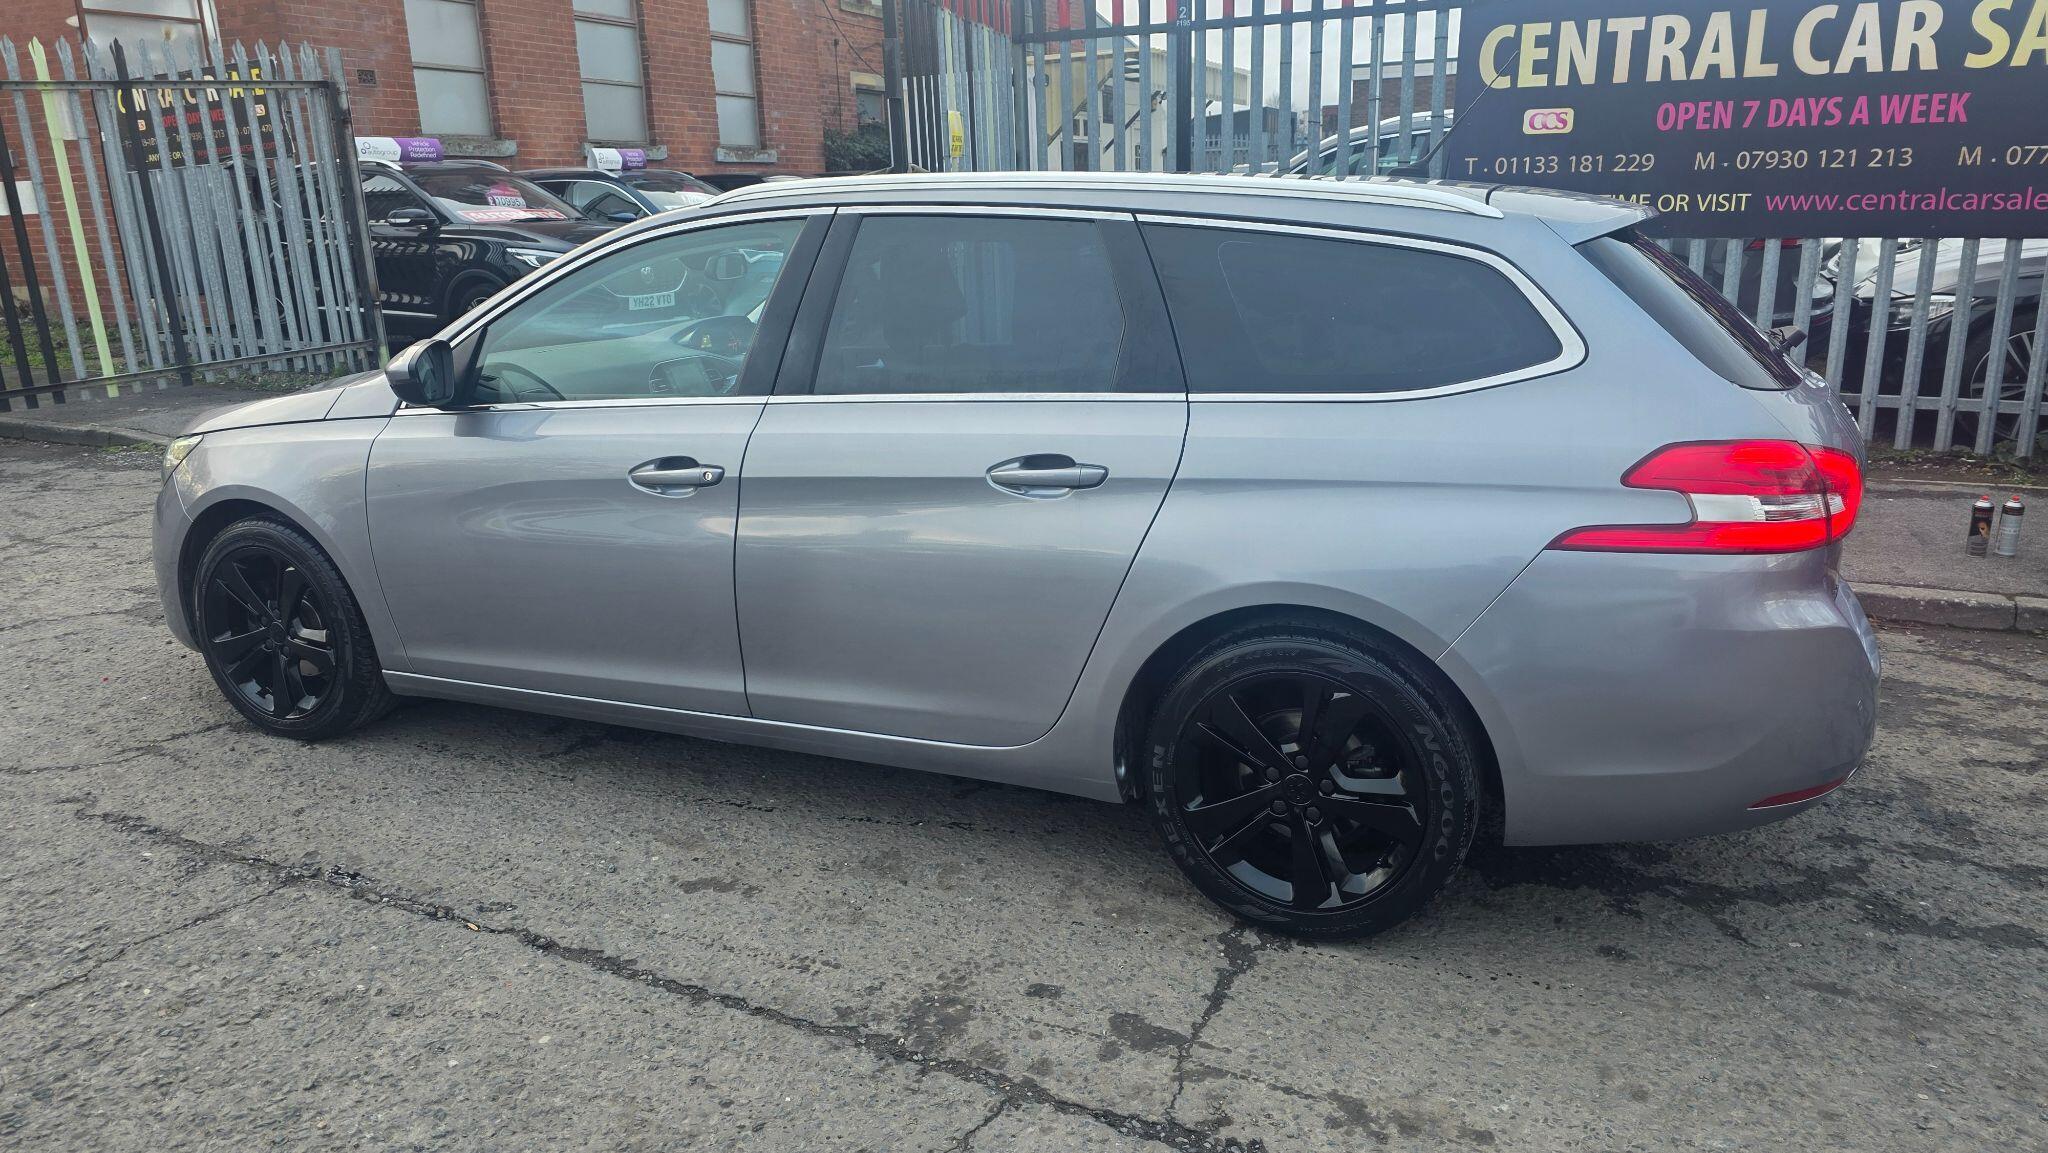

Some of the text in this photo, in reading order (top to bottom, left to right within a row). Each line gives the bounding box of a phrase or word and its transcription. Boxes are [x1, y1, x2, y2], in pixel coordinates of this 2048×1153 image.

[1179, 6, 1187, 19] 2
[1479, 9, 1778, 90] CENTRAL
[1792, 0, 1944, 75] CAR
[1528, 111, 1568, 131] CCS
[1656, 92, 1971, 131] OPEN 7 DAYS A WEEK
[1495, 156, 1558, 175] 01133
[1569, 155, 1603, 173] 181
[1613, 153, 1655, 173] 229
[1736, 150, 1808, 169] 07930
[1819, 148, 1857, 169] 121
[1867, 147, 1913, 168] 213
[1658, 194, 1690, 212] OR
[1697, 193, 1752, 212] VISIT
